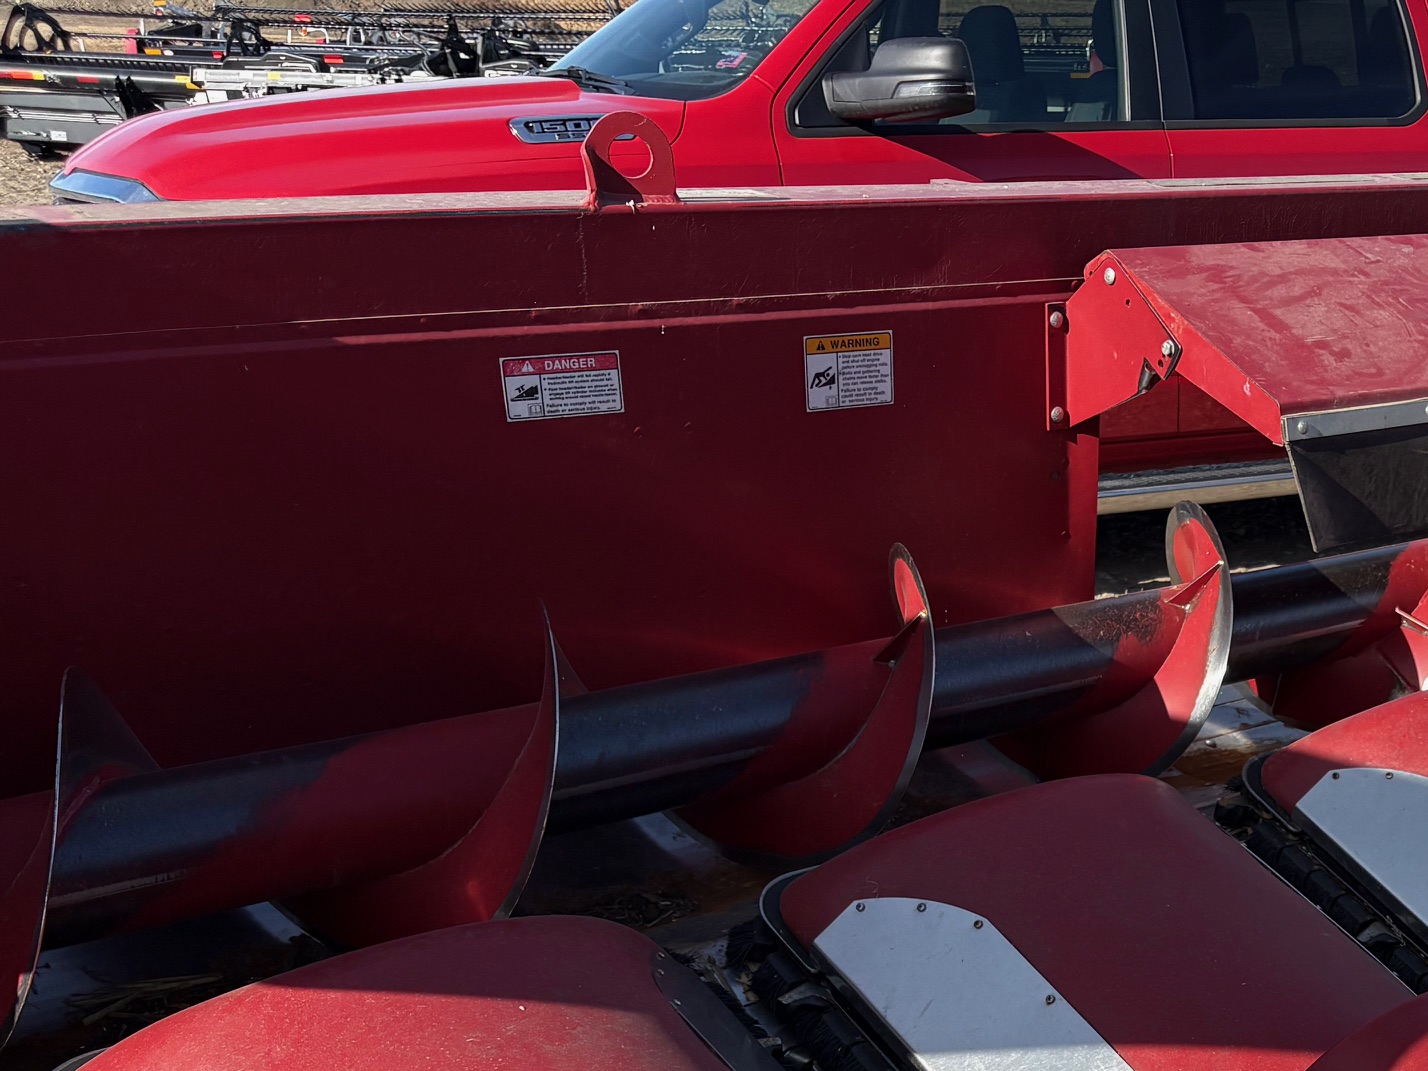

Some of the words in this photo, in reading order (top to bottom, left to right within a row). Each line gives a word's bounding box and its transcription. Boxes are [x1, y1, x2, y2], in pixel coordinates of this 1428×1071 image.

[533, 120, 596, 133] 150
[830, 337, 880, 349] WARNING
[545, 358, 595, 370] DANGER
